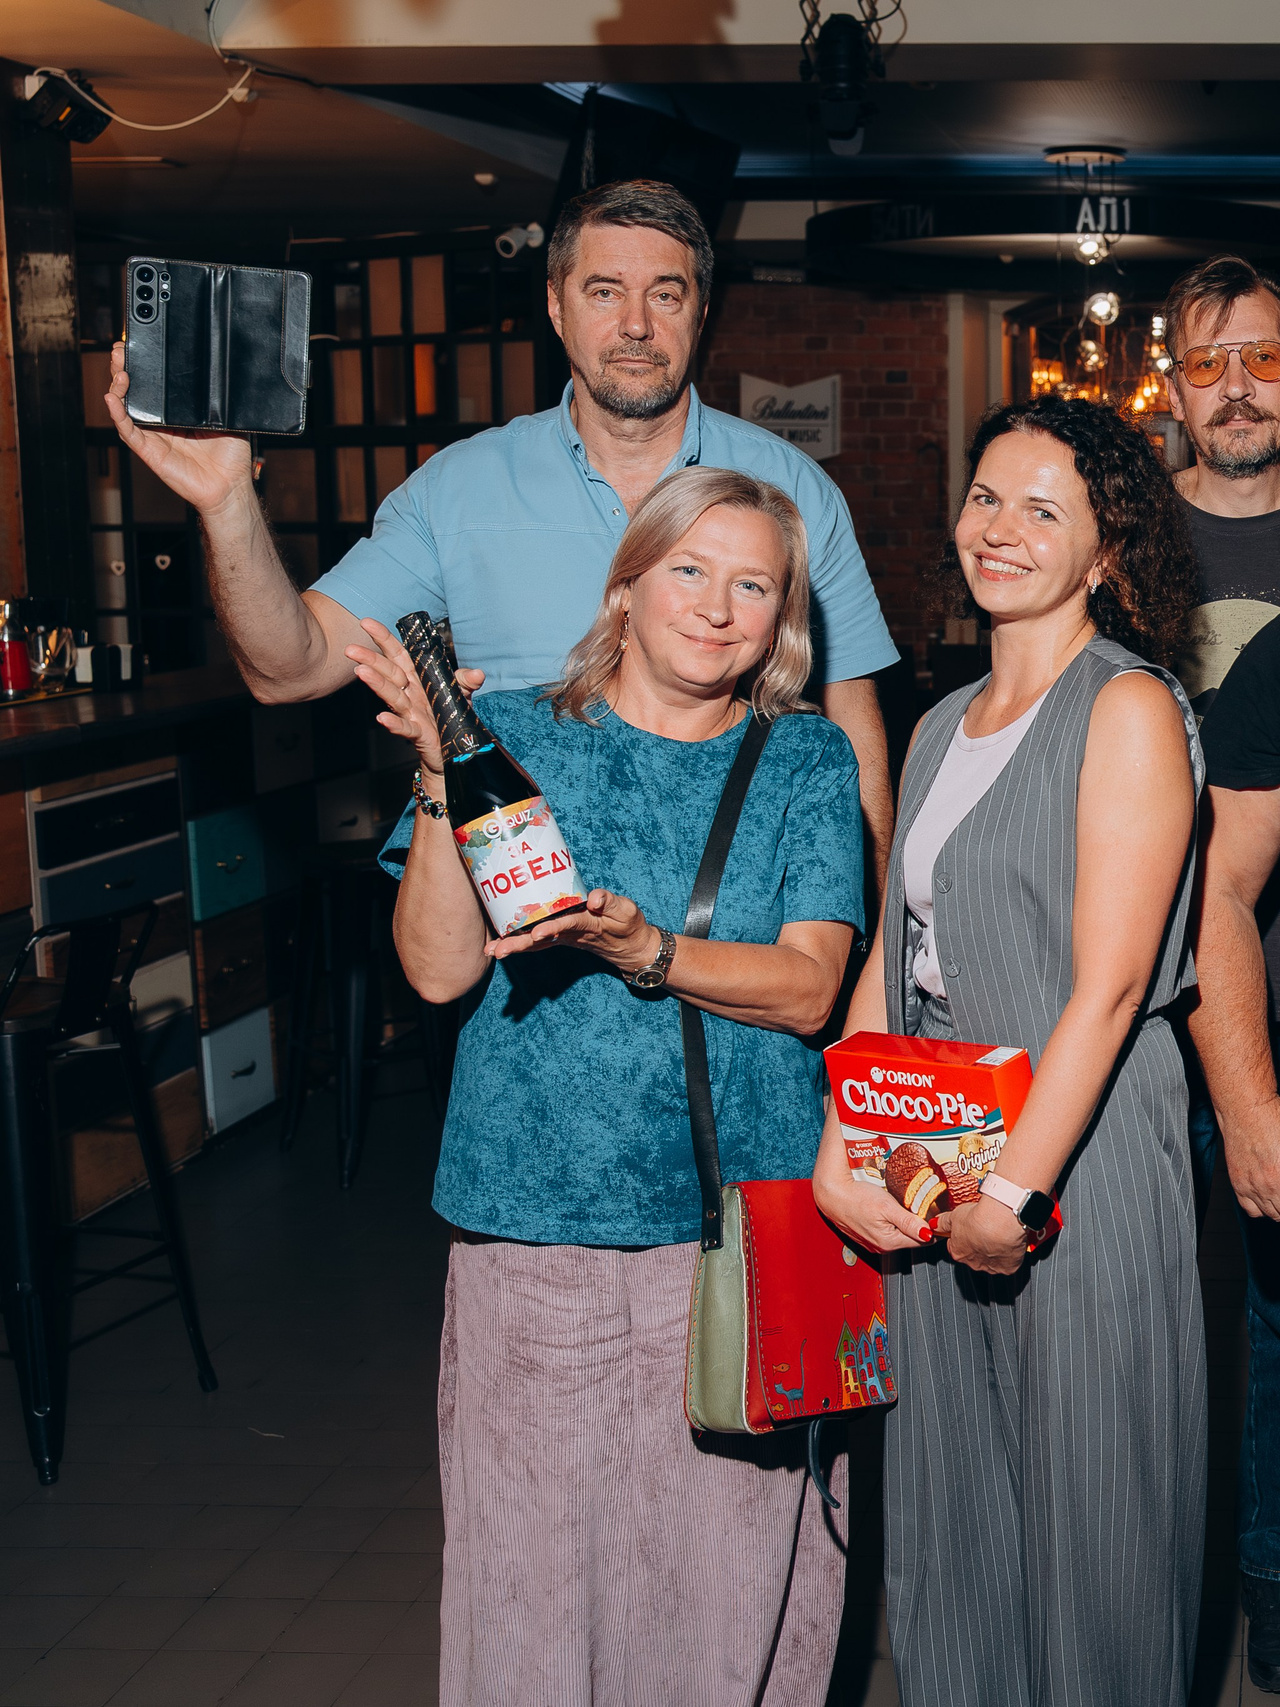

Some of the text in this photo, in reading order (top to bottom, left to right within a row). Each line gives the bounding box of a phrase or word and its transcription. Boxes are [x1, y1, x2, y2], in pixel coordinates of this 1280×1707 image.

[503, 809, 534, 829] QUIZ
[480, 847, 573, 902] ПОБЕДУ
[886, 1070, 933, 1089] ORION
[957, 1139, 1002, 1175] Original
